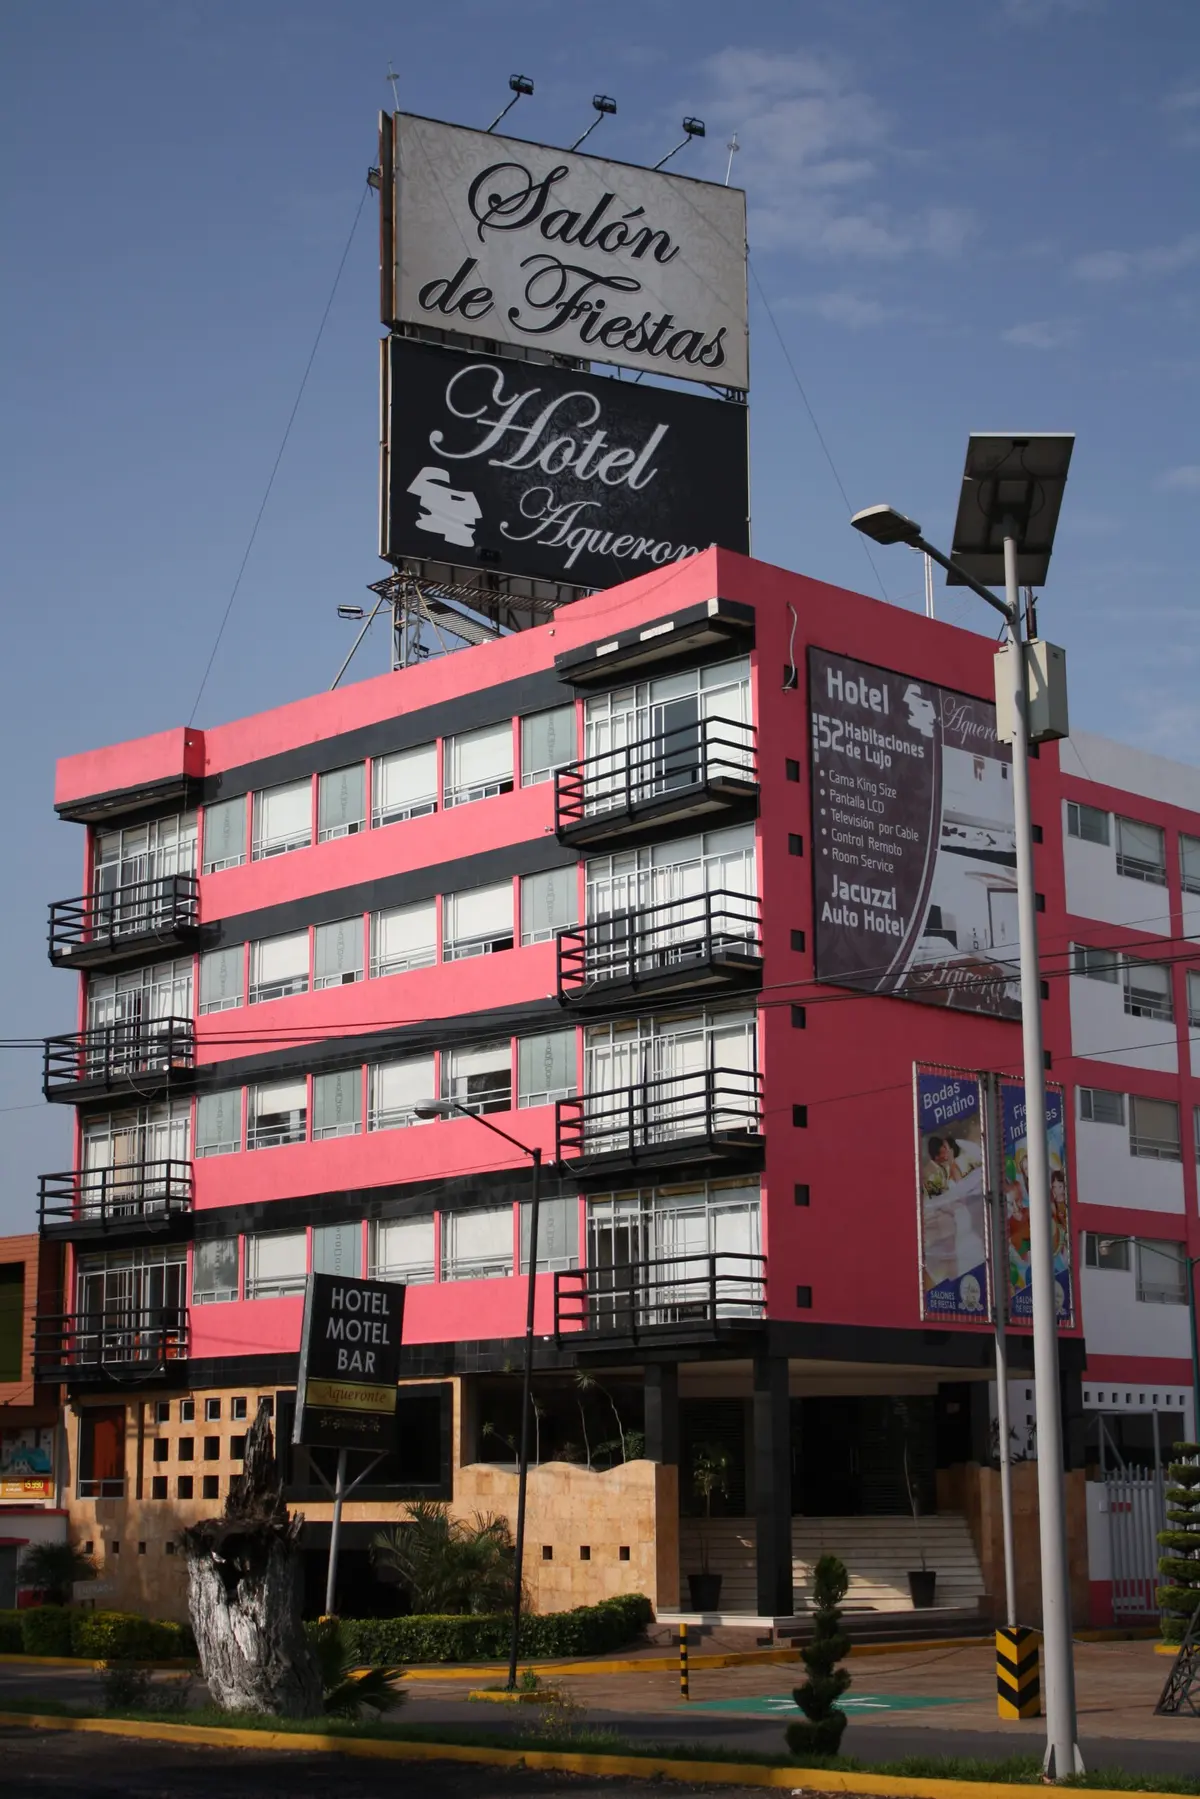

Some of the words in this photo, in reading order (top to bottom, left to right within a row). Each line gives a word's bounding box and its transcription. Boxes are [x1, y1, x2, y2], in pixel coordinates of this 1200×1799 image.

[468, 162, 680, 264] Salón
[418, 257, 495, 320] de
[508, 253, 727, 368] Fiestas
[429, 363, 670, 490] Hotel
[827, 667, 889, 715] Hotel
[844, 720, 925, 758] Habitaciones
[846, 740, 861, 760] de
[864, 744, 892, 770] Lujo
[828, 769, 855, 788] Cama
[856, 776, 877, 797] King
[878, 782, 897, 799] Size
[829, 788, 865, 810] Pantalla
[866, 797, 885, 814] LCD
[830, 807, 875, 831] Televisión
[878, 822, 894, 837] por
[895, 824, 919, 842] Cable
[831, 827, 864, 848] Control
[867, 836, 903, 857] Remoto
[831, 847, 859, 866] Room
[860, 853, 894, 873] Service
[831, 873, 897, 911] Jacuzzi
[821, 901, 859, 928] Auto
[863, 908, 905, 937] Hotel
[923, 1081, 961, 1110] Bodas
[933, 1093, 975, 1124] Platino
[331, 1287, 390, 1315] HOTEL
[326, 1316, 390, 1345] MOTEL
[337, 1348, 376, 1374] BAR
[314, 1385, 387, 1404] Aqueronte
